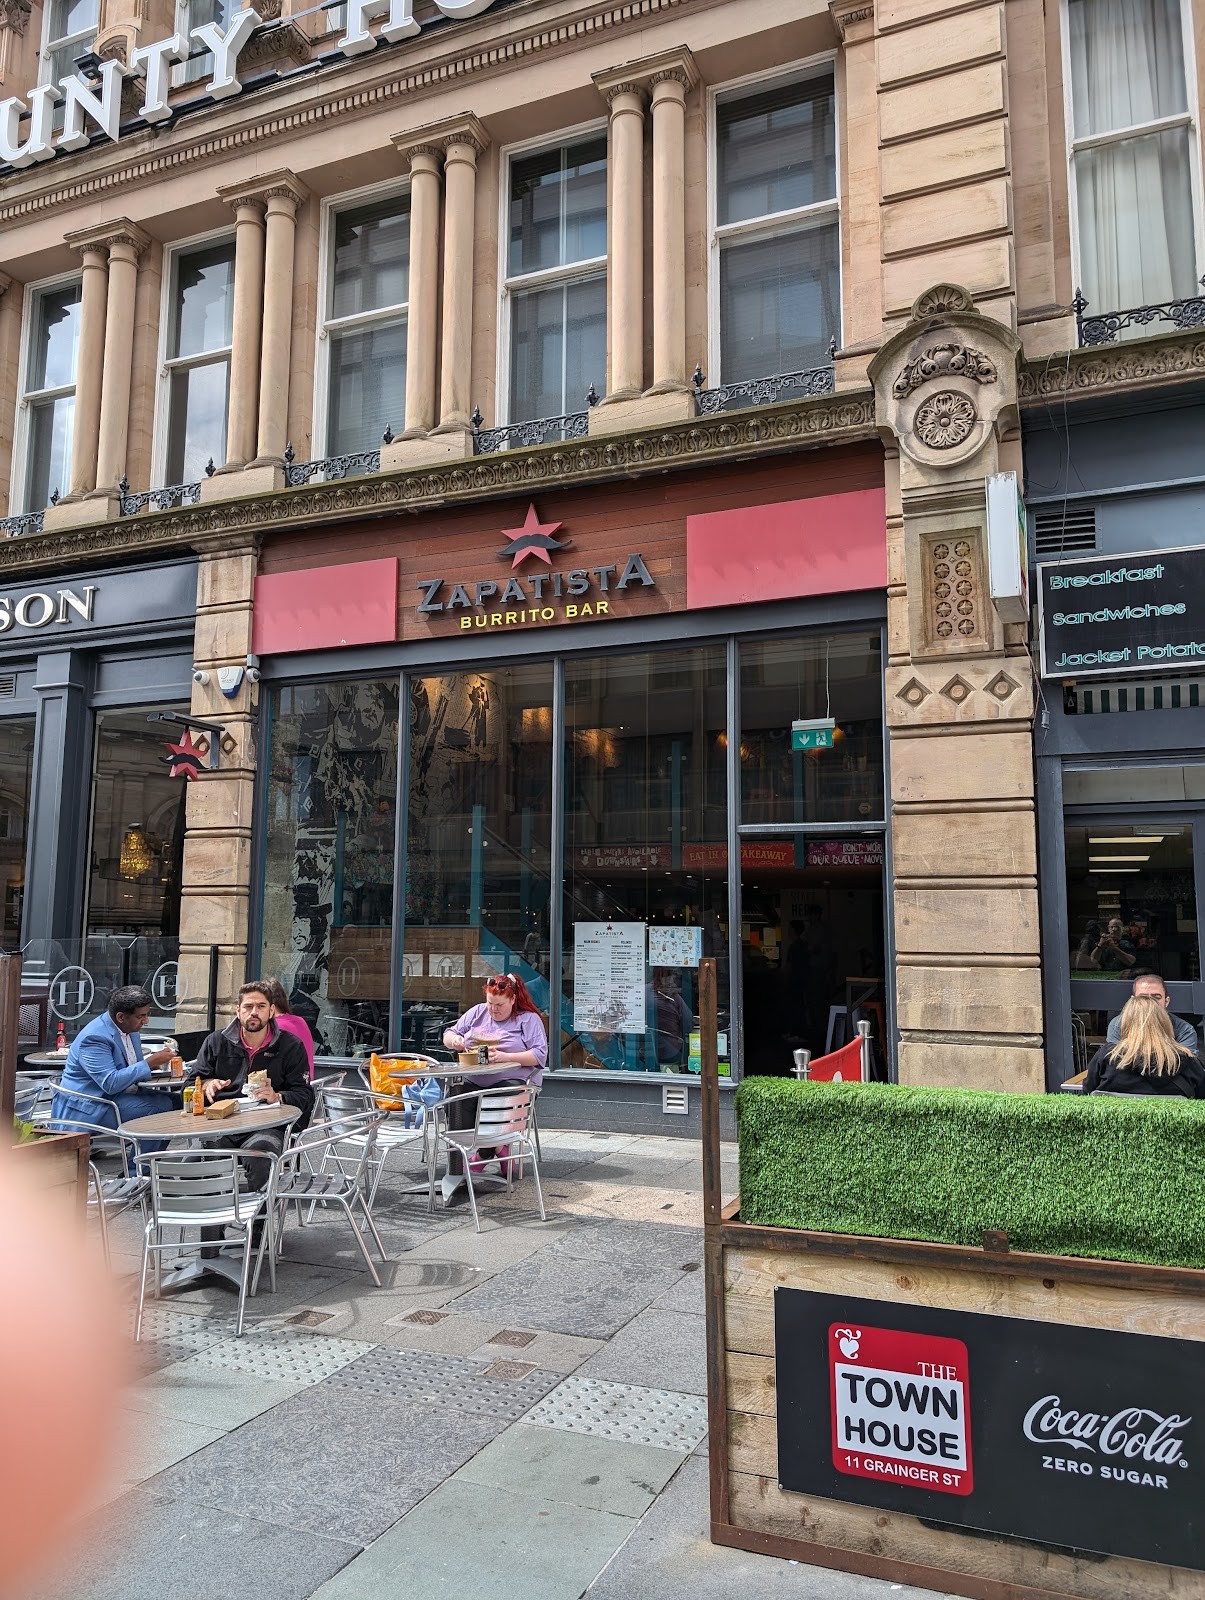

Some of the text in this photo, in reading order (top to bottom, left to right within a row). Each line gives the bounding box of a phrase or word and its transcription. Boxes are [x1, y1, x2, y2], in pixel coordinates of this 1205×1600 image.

[0, 0, 498, 168] UNTY H
[416, 553, 655, 613] ZAPATISTA
[1050, 564, 1164, 590] Breakfast
[460, 601, 609, 629] BURRITO BAR
[1052, 602, 1186, 626] Sandwiches
[1055, 647, 1131, 667] Jacket
[689, 852, 705, 861] EAT
[740, 849, 787, 861] AKEAWAY
[812, 855, 830, 865] OUR
[832, 855, 860, 865] QUEUE
[917, 1361, 958, 1382] THE
[841, 1372, 959, 1420] TOWN
[844, 1416, 960, 1461] HOUSE
[1023, 1395, 1193, 1468] Coca-Cola
[845, 1456, 962, 1488] 11 GRAINGER ST
[1042, 1456, 1169, 1489] ZERO SUGAR
